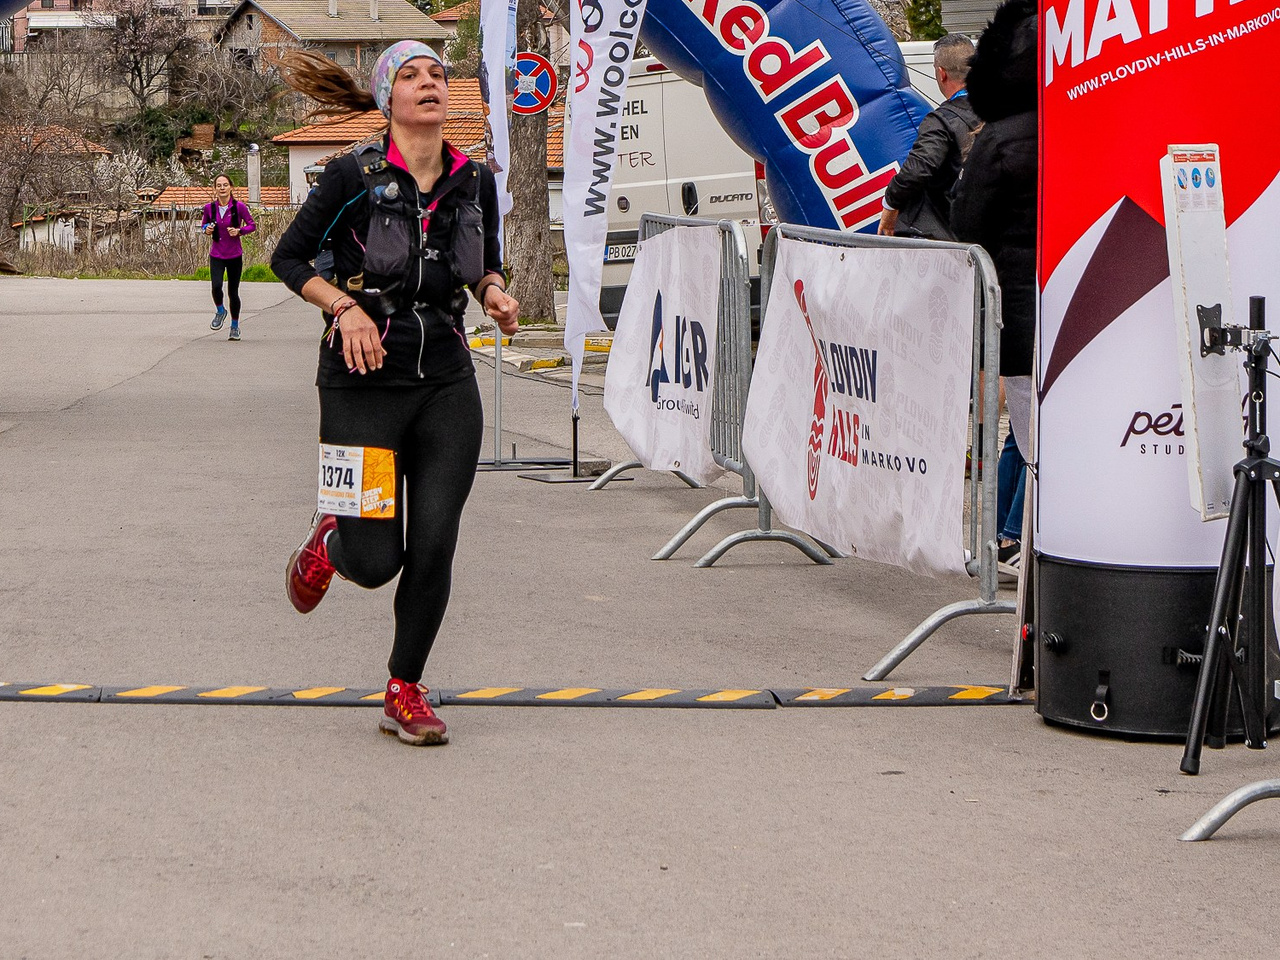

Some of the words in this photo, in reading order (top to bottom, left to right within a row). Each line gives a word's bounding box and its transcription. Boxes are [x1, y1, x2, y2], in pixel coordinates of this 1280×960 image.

[780, 79, 900, 230] Bull
[709, 192, 754, 204] DUCATO
[608, 246, 620, 259] PB
[819, 339, 878, 404] OVDIV
[861, 423, 871, 441] IN
[1140, 443, 1185, 456] STUD
[322, 464, 355, 490] 1374
